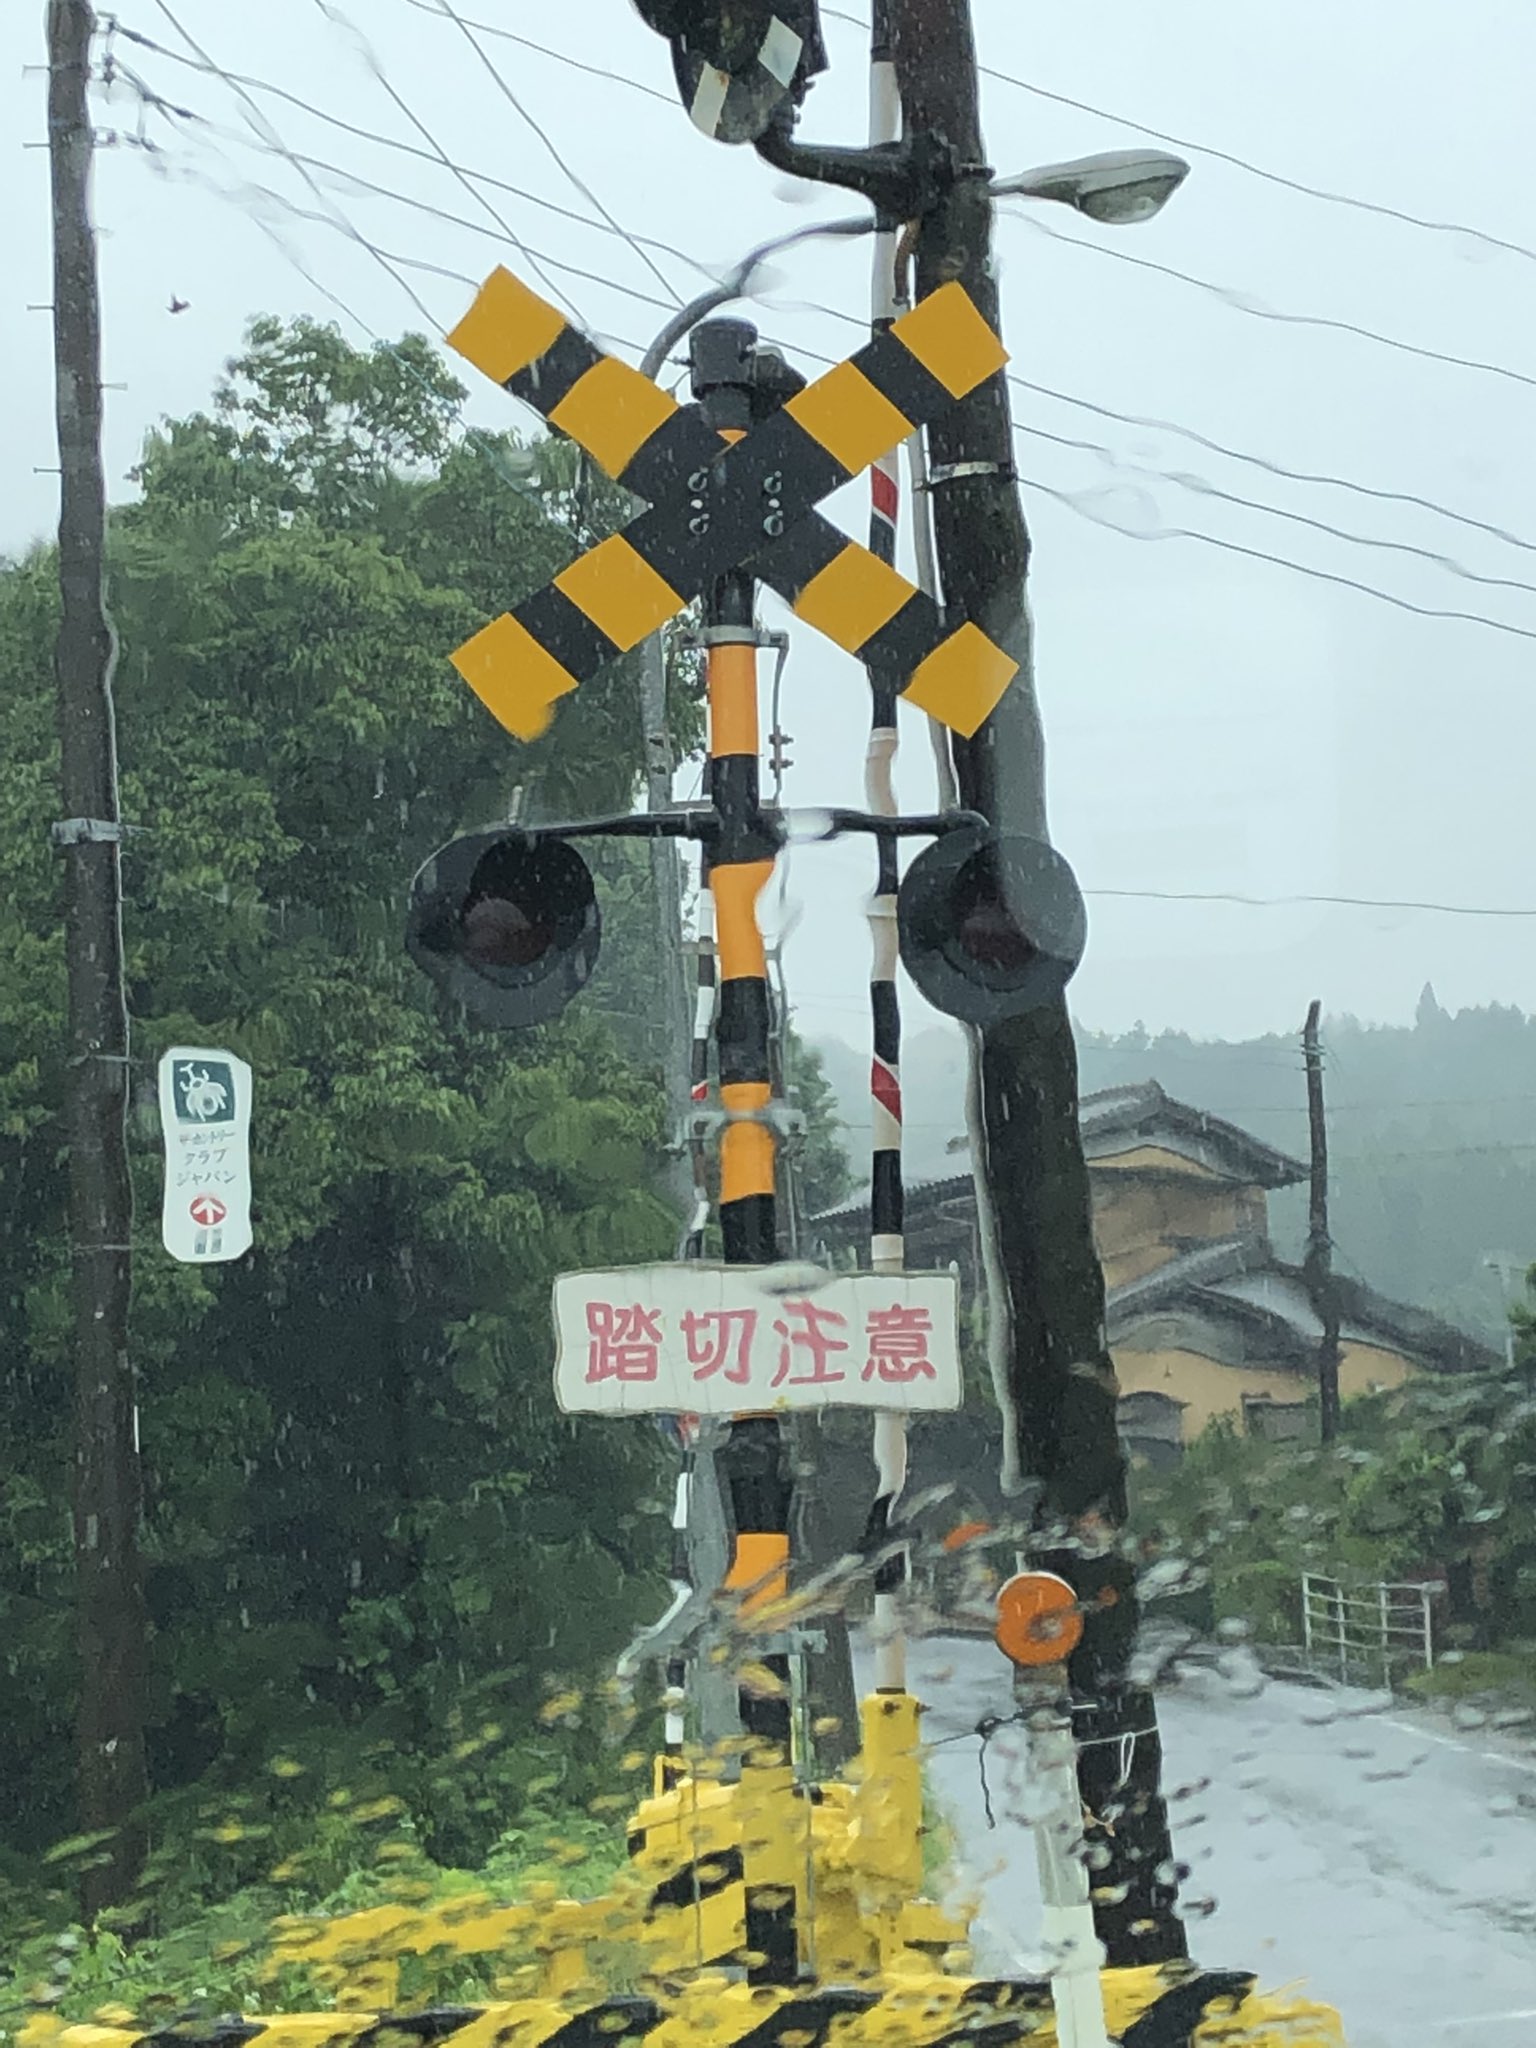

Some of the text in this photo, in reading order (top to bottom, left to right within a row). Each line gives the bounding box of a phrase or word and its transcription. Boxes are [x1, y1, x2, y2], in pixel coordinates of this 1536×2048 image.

[176, 1170, 236, 1187] ジャパン
[585, 1297, 937, 1388] 踏切注意
